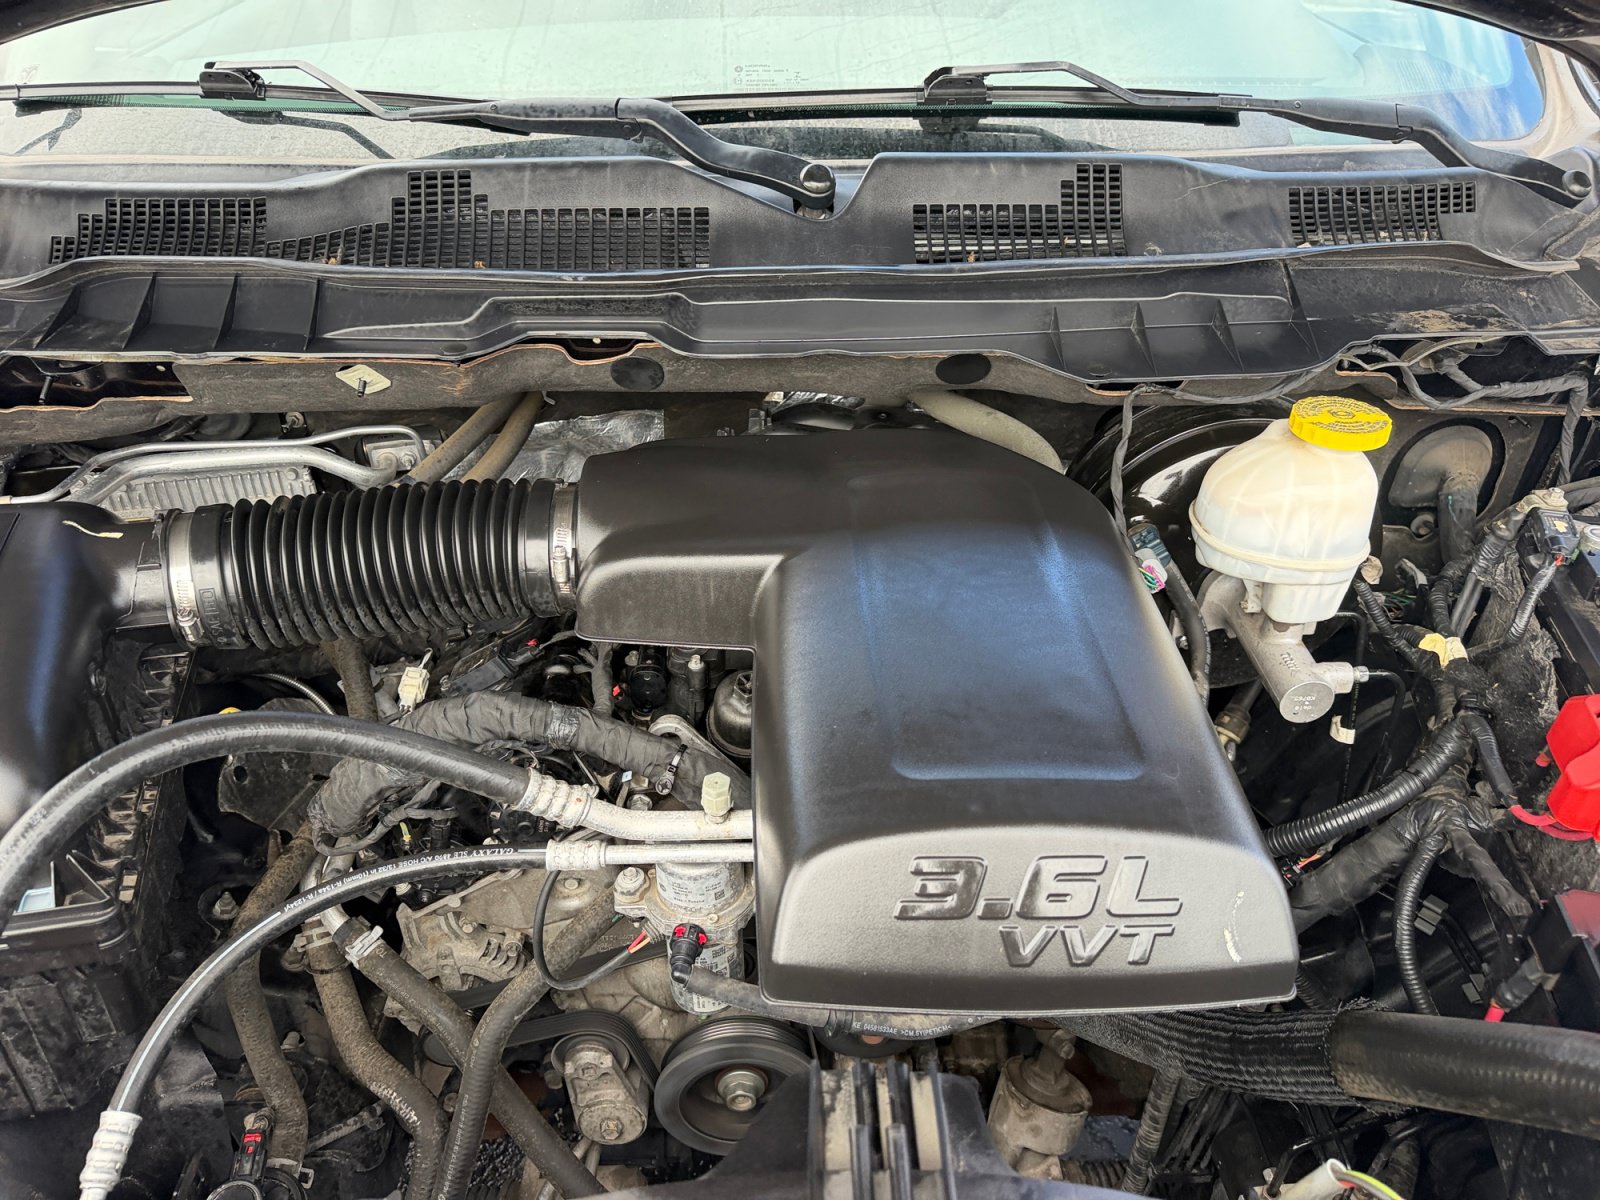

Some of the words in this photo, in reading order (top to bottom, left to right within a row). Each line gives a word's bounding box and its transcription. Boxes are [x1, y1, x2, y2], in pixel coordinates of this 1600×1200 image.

[470, 847, 514, 857] GALAXY
[399, 858, 419, 867] HOSE
[420, 855, 433, 863] A/C
[378, 864, 397, 873] 13/32
[343, 870, 369, 884] (10mm)
[318, 881, 342, 894] R-134a
[894, 855, 1182, 920] 3.6L
[284, 893, 314, 912] R-1234yf
[999, 924, 1175, 967] VVT
